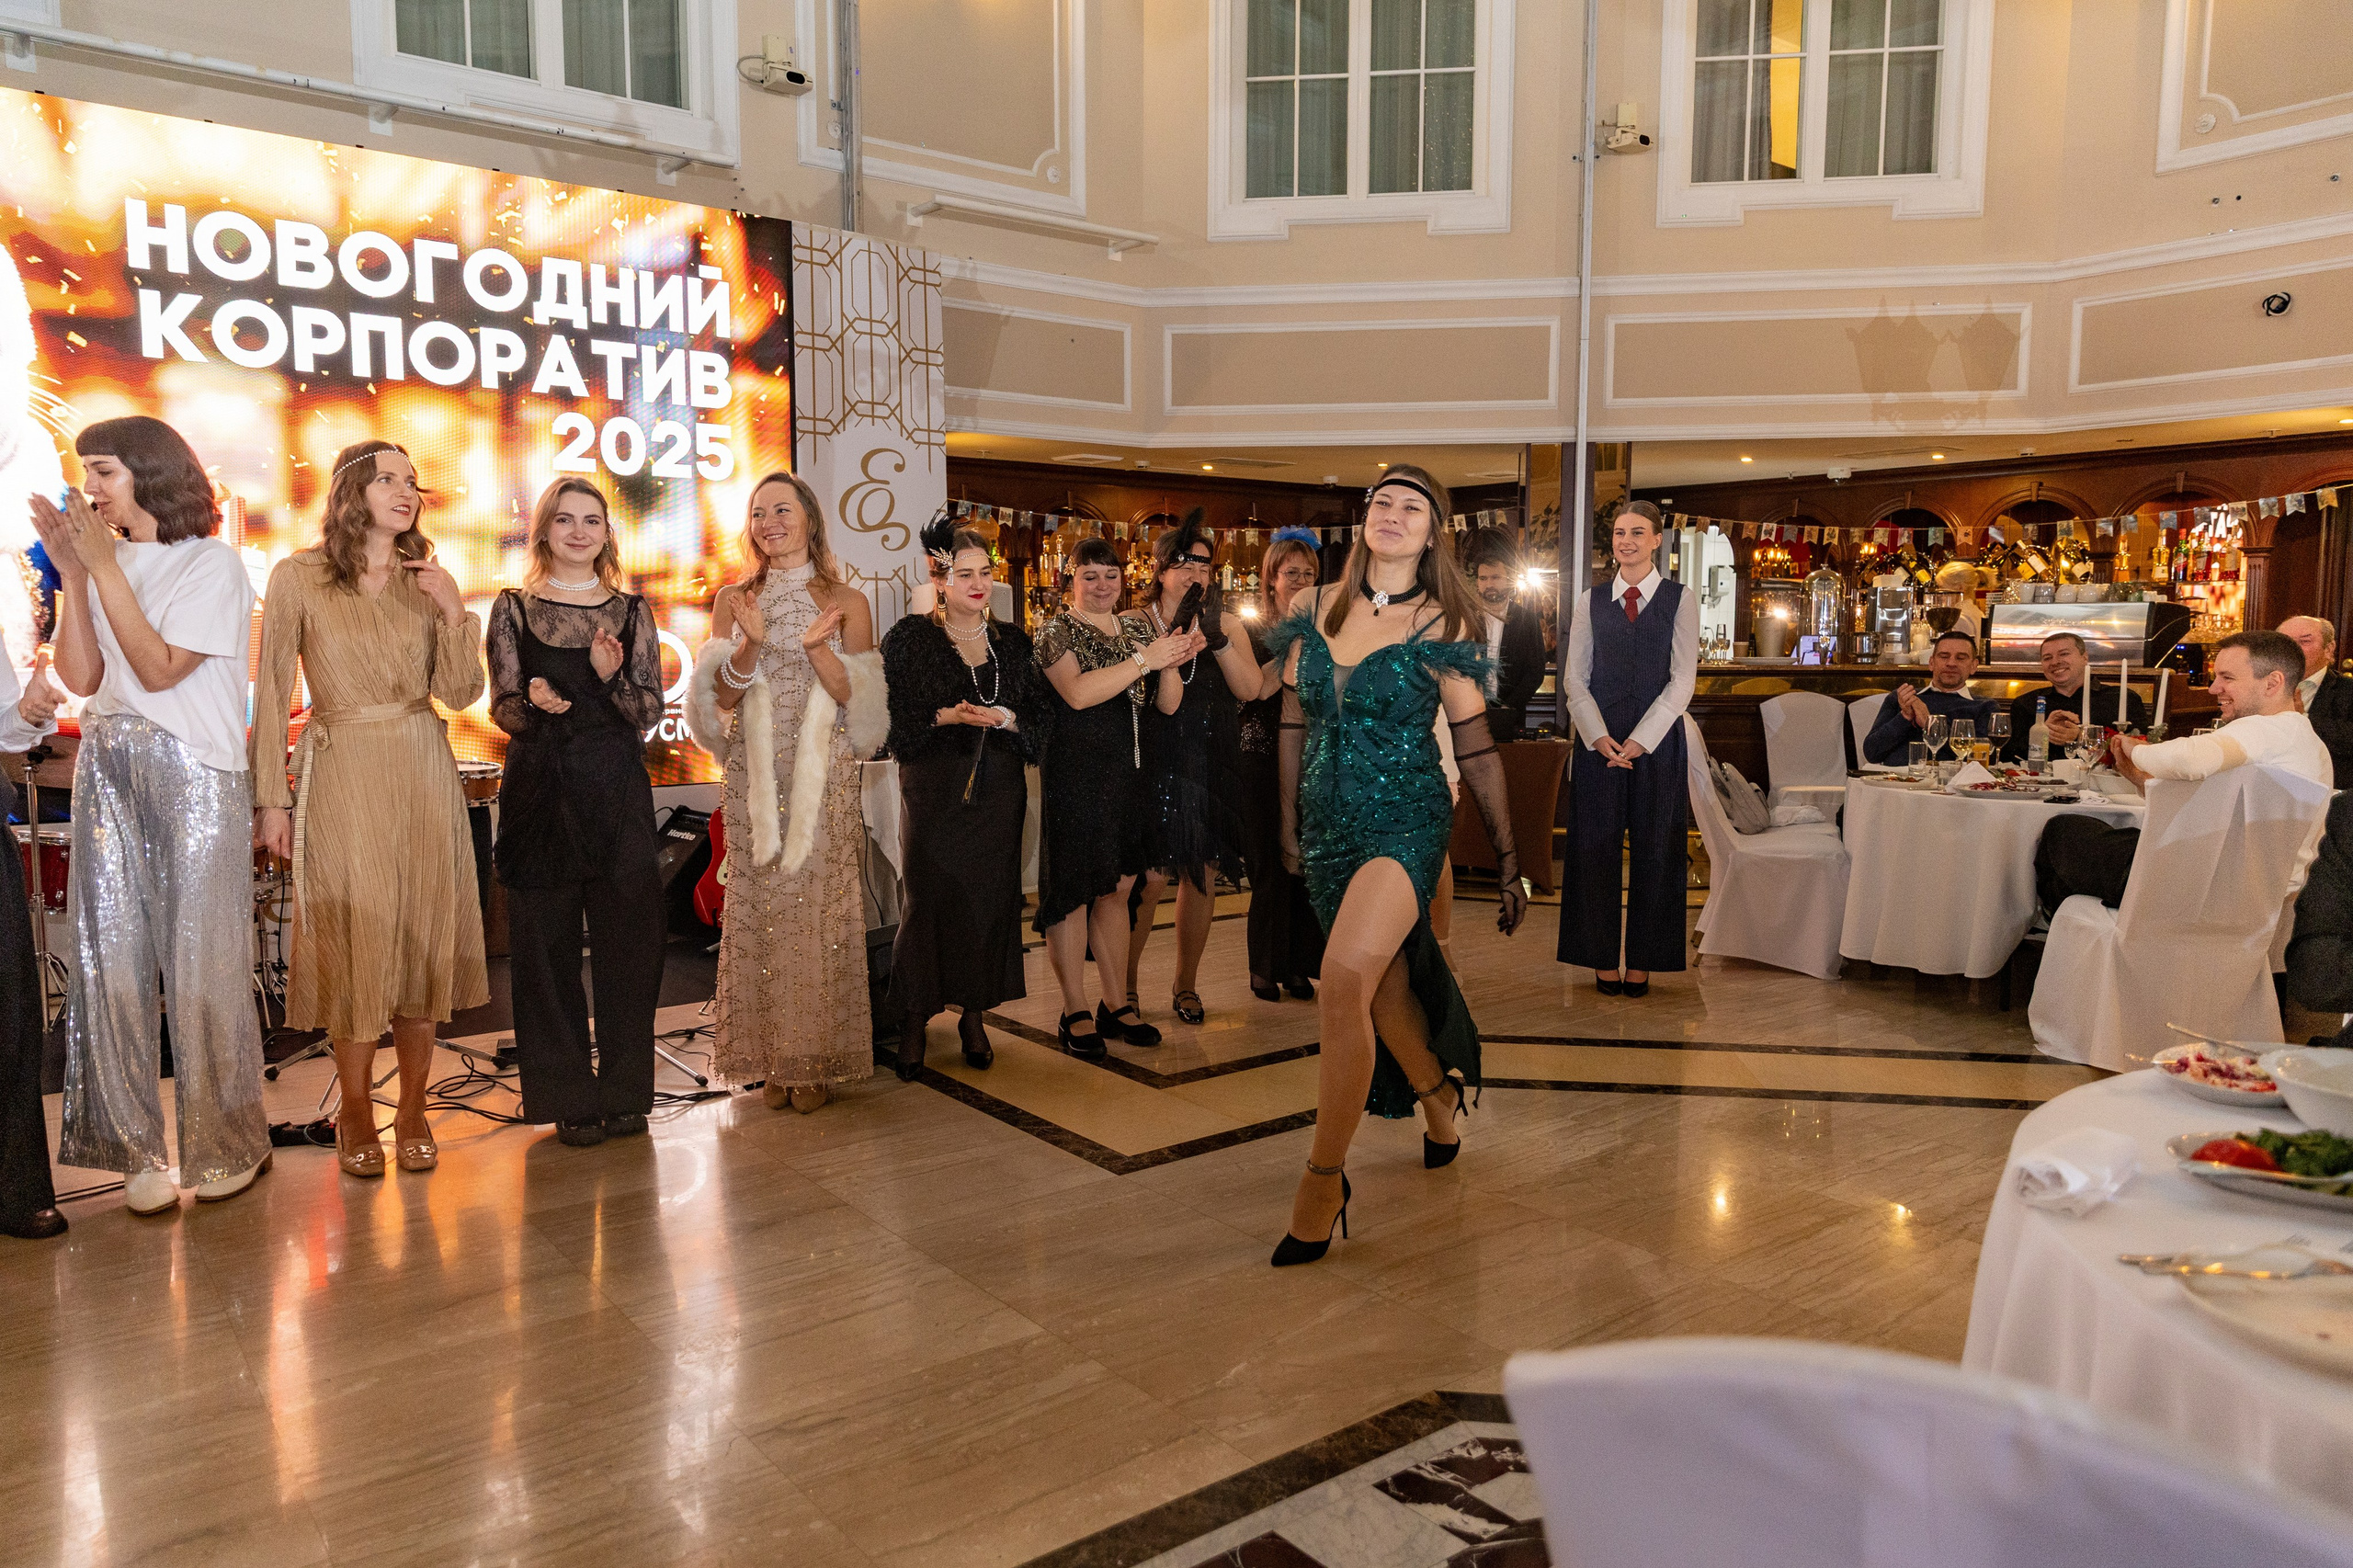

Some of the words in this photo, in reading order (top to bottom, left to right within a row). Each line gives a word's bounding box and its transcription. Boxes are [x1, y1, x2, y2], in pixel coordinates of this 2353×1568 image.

[125, 199, 732, 339] НОВОГОДНИЙ
[138, 290, 733, 409] КОРПОРАТИВ
[552, 412, 734, 482] 2025
[666, 828, 696, 841] Hartke
